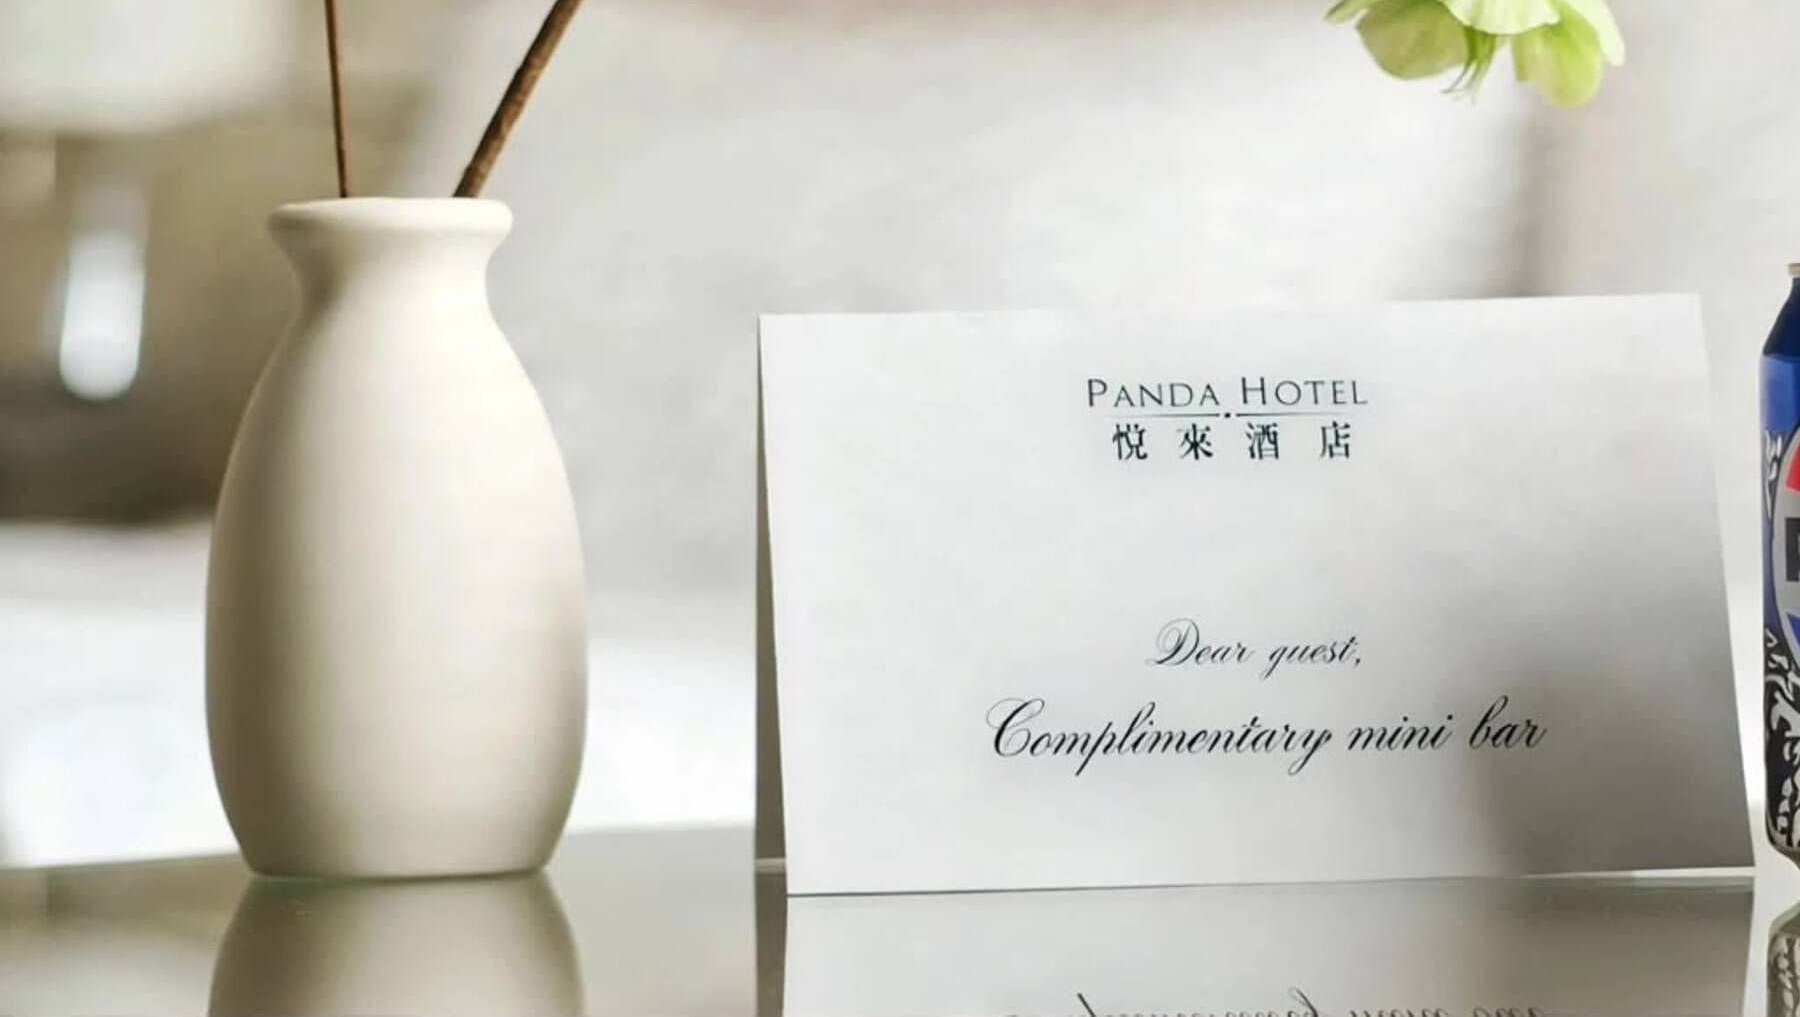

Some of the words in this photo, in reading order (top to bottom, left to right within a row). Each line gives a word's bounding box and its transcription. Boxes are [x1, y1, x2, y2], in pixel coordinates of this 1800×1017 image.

[1086, 378, 1221, 408] PANDA
[1240, 376, 1369, 406] HOTEL
[1147, 618, 1255, 666] Dear
[1258, 635, 1362, 681] guest,
[985, 696, 1335, 778] Complimentary
[1347, 713, 1455, 752] mini
[1468, 694, 1550, 751] bar
